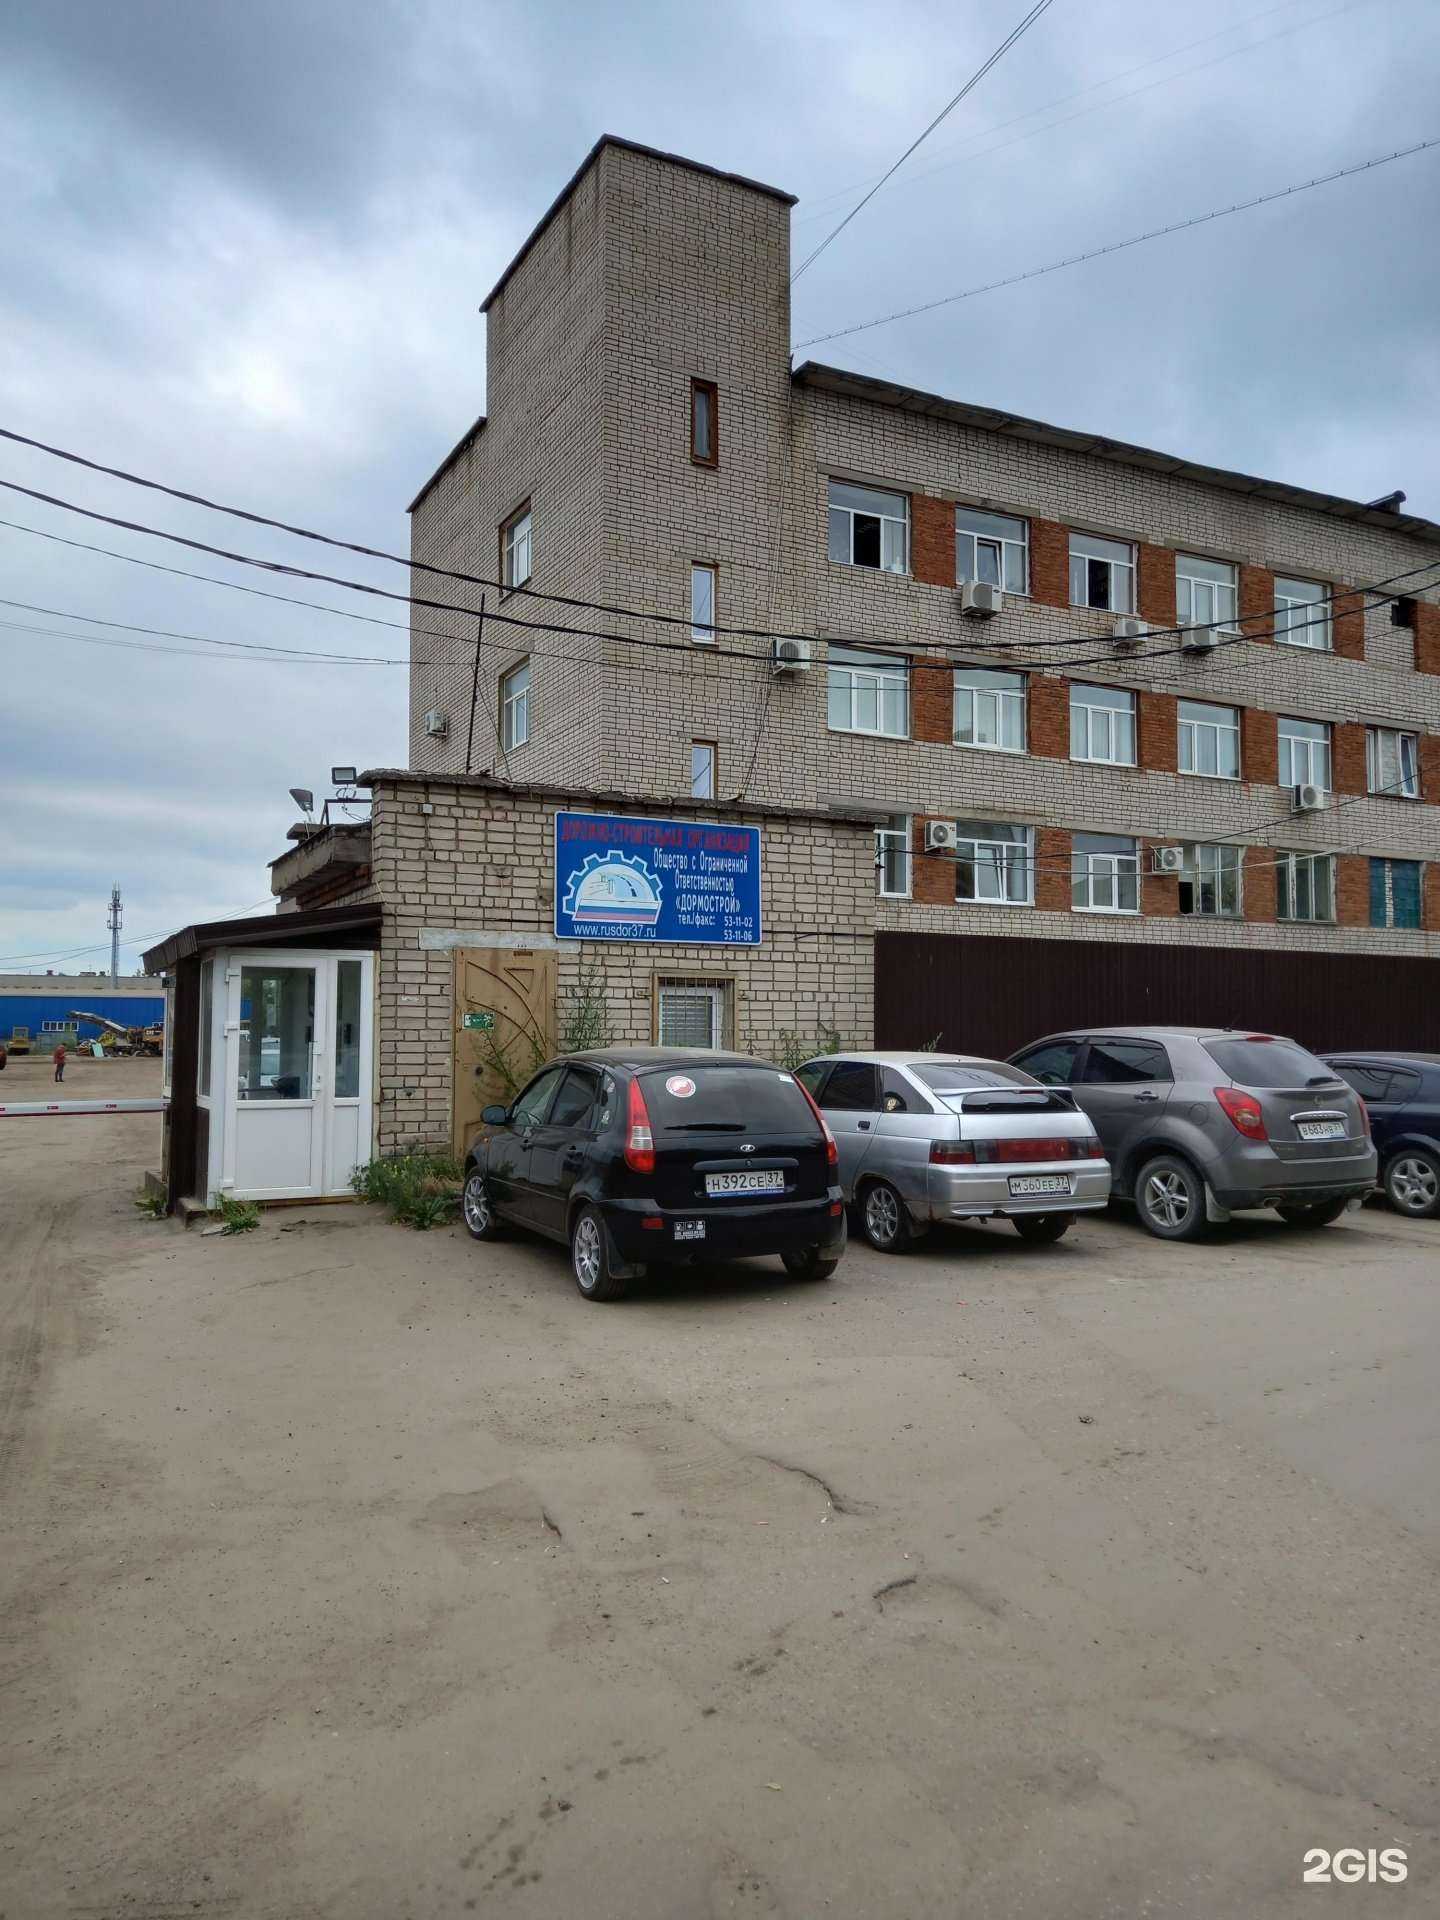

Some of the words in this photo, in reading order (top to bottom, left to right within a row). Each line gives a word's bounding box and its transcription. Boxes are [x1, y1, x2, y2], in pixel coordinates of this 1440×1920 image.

[653, 847, 688, 871] Общество
[691, 859, 696, 870] с
[699, 851, 748, 875] Ограниченной
[675, 870, 734, 891] Ответственностью
[675, 893, 741, 914] «ДОРМОСТРОЙ»
[678, 914, 716, 929] тел./факс:
[724, 916, 753, 928] 53-11-02
[574, 924, 656, 938] www.rusdor37.ru
[724, 930, 753, 941] 53-11-06
